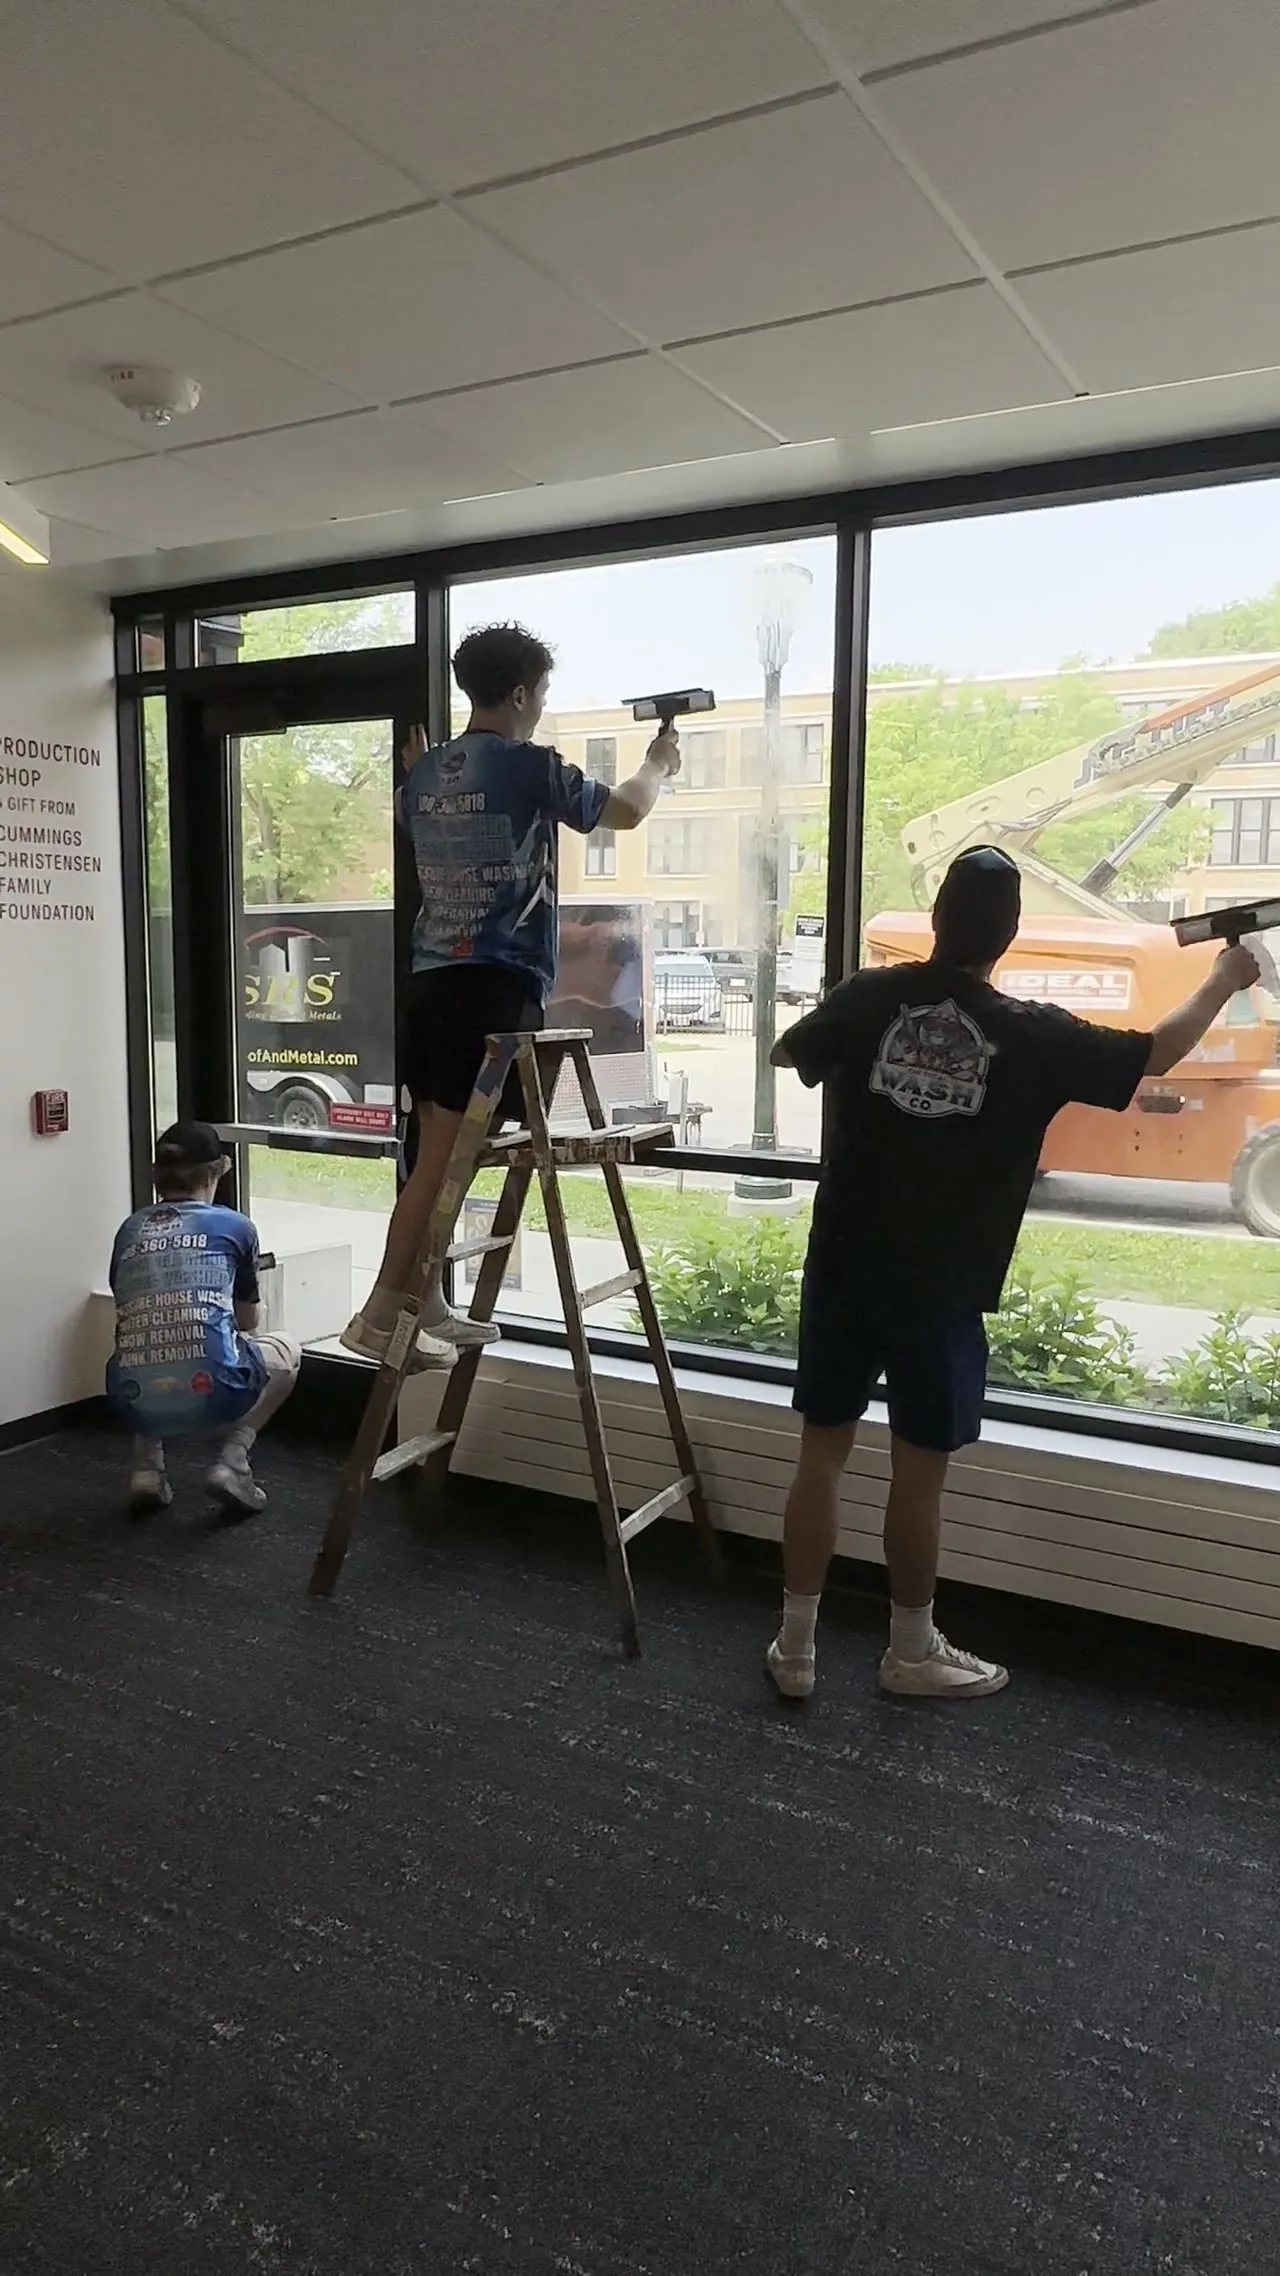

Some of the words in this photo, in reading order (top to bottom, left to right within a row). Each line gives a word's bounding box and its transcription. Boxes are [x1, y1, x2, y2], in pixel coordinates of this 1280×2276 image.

[7, 796, 36, 812] GIFT
[40, 799, 76, 816] FROM
[0, 825, 82, 847] CUMMINGS
[0, 852, 101, 873] CHRISTENSEN
[0, 877, 52, 895] FAMILY
[0, 904, 95, 921] FOUNDATION
[155, 1290, 194, 1308] HOUSE
[152, 1307, 209, 1326] CLEANING
[150, 1325, 207, 1345] REMOVAL
[150, 1344, 208, 1365] REMOVAL
